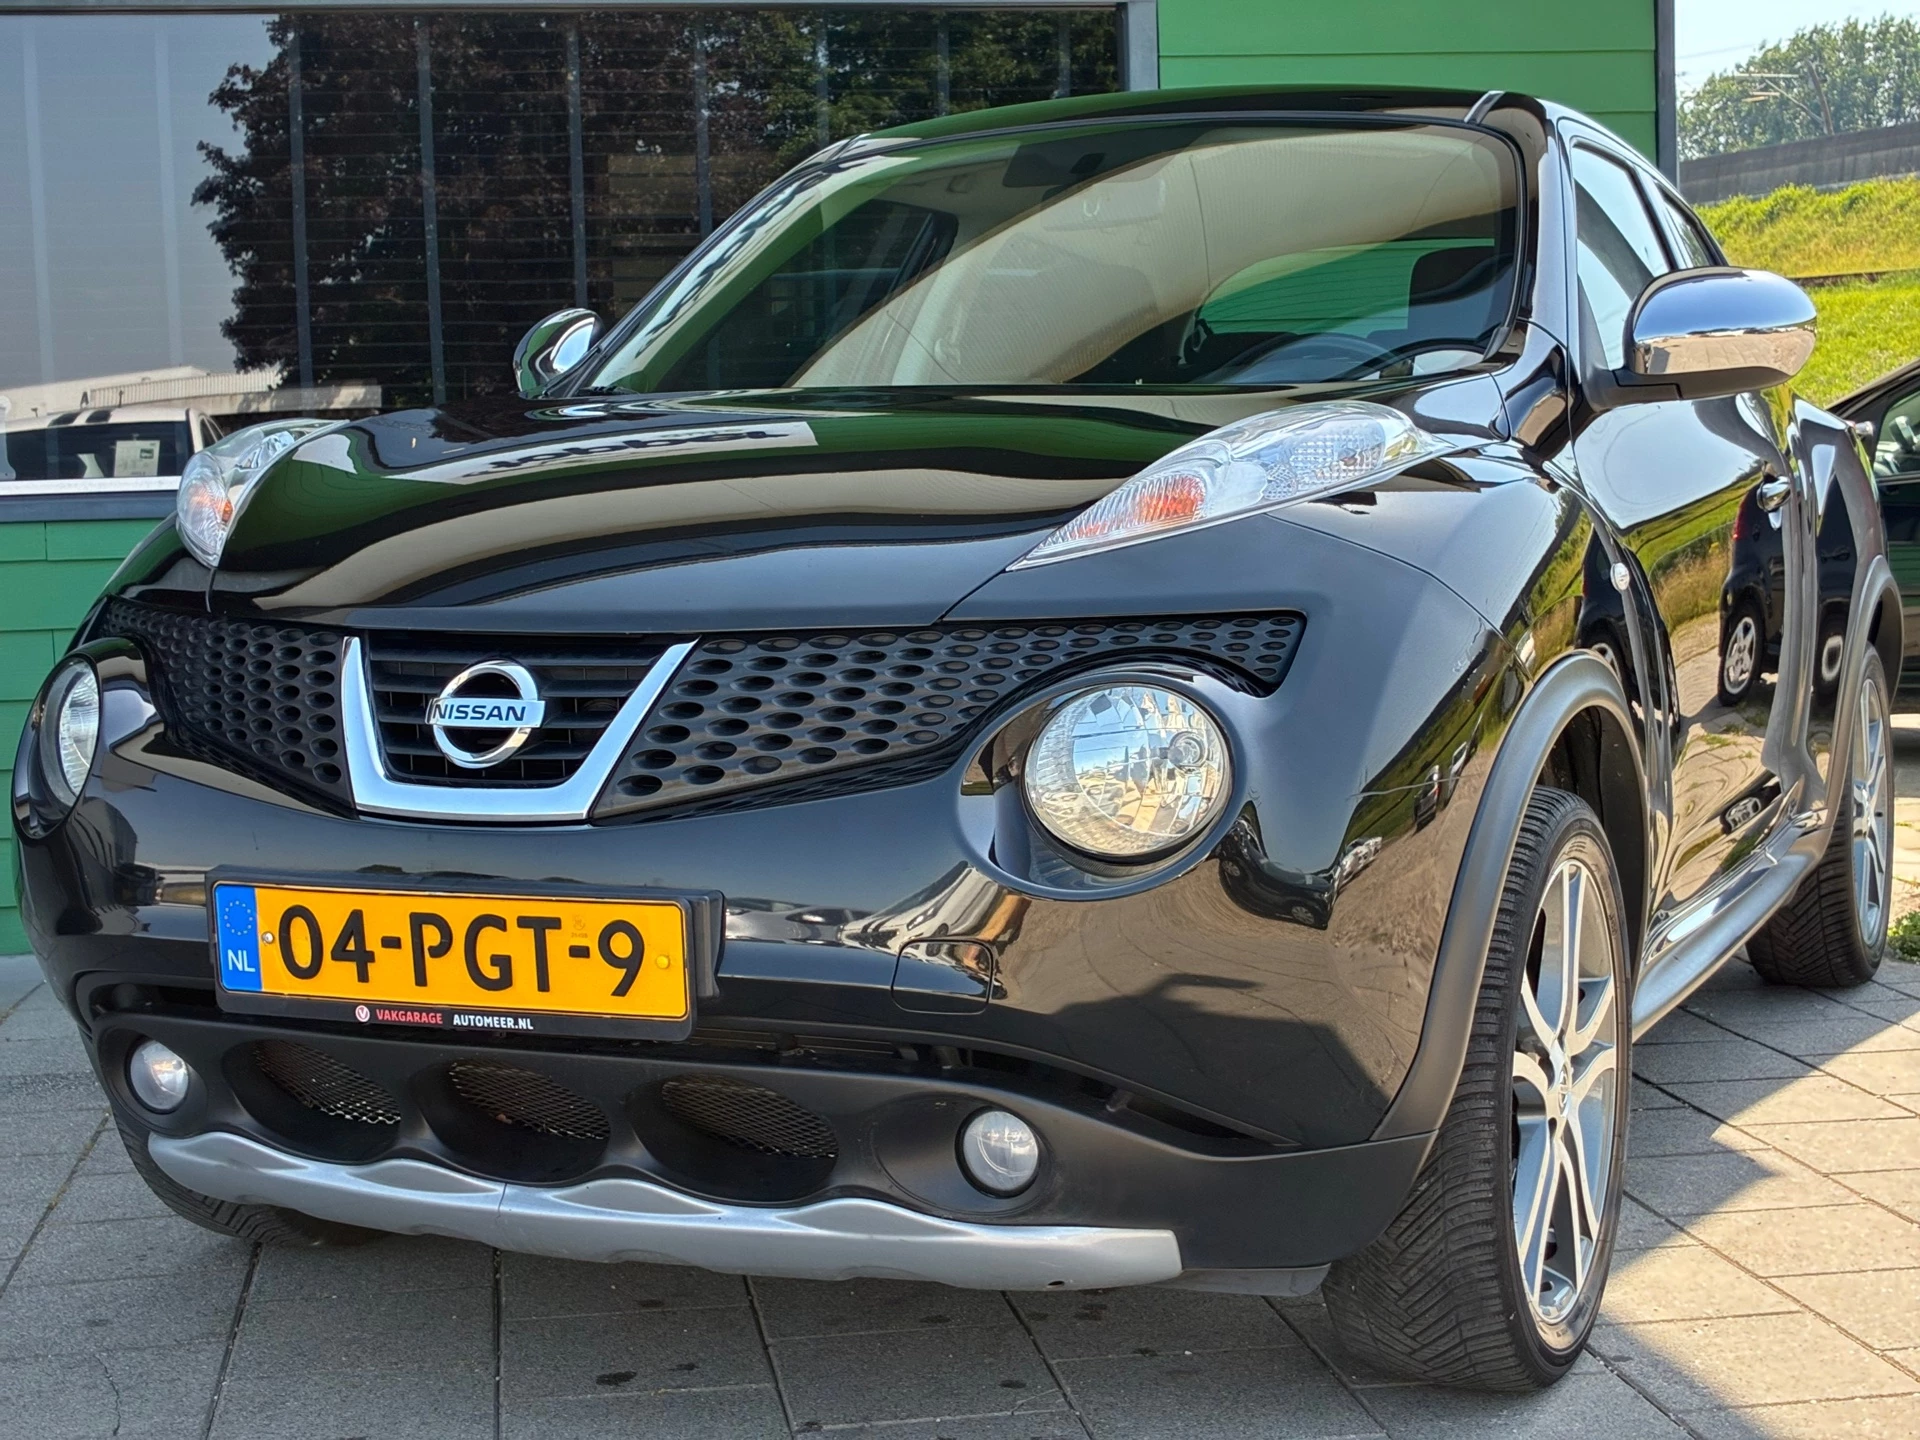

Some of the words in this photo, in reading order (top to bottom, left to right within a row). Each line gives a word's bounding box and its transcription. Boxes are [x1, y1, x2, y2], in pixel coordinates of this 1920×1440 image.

[432, 703, 526, 722] NISSAN
[227, 949, 256, 973] NL
[278, 904, 645, 997] 04-PGT-9
[376, 1008, 443, 1025] VAKGARAGE
[453, 1013, 534, 1031] AUTOMEER.NL
